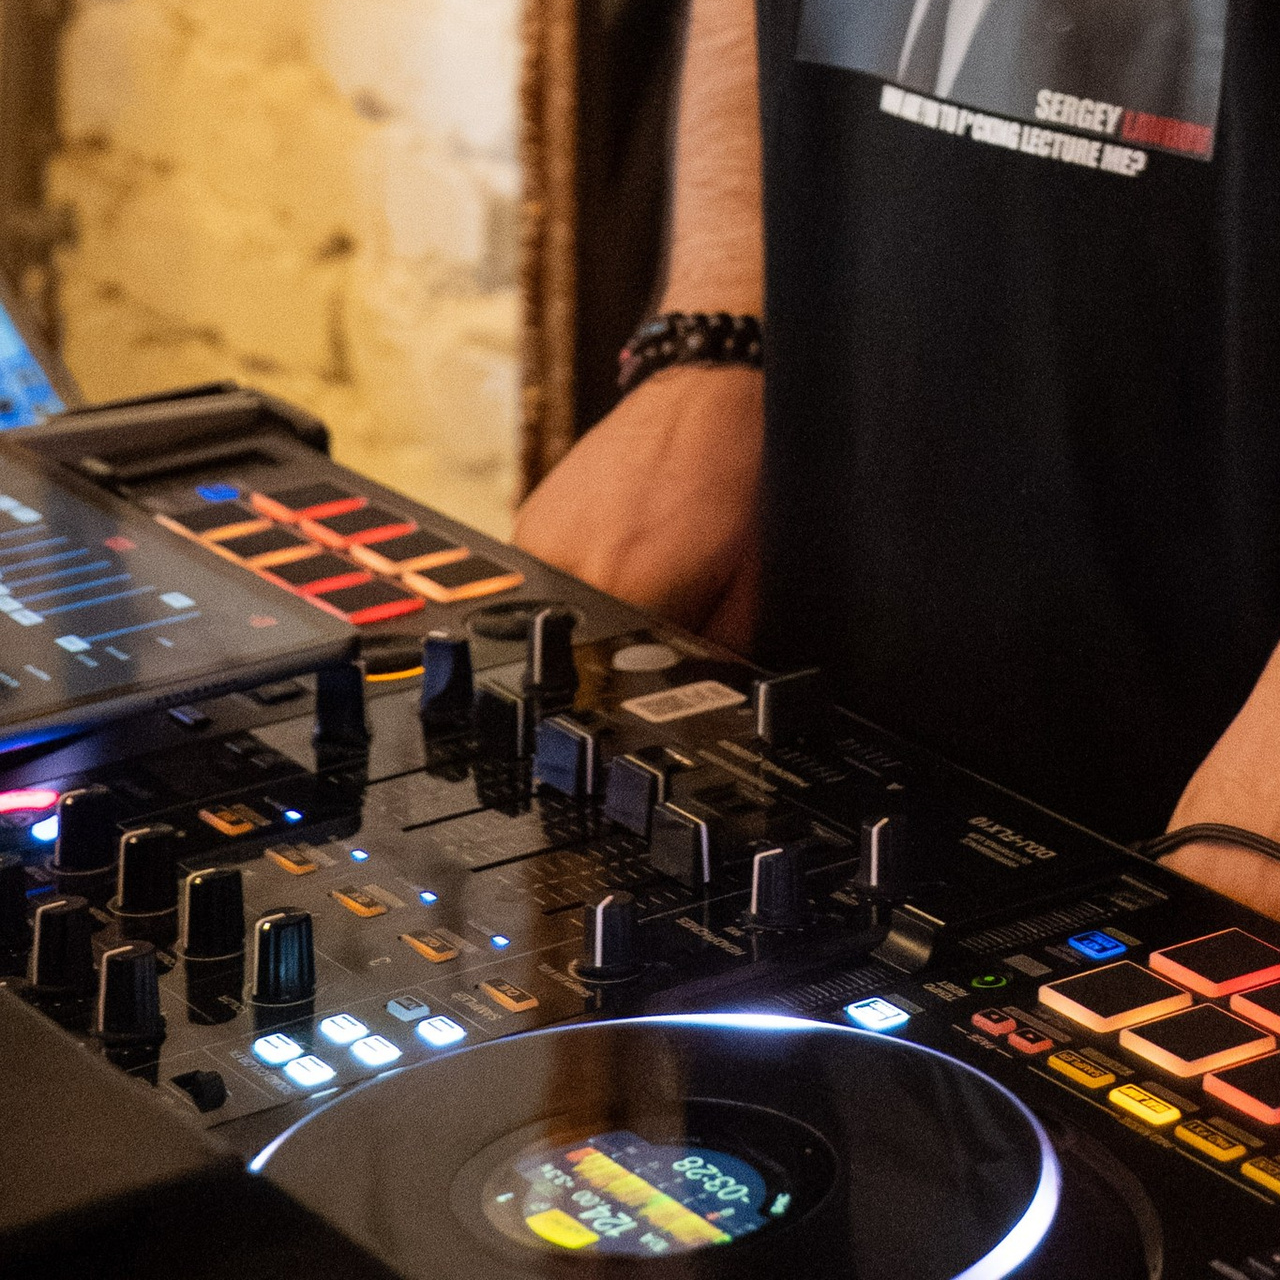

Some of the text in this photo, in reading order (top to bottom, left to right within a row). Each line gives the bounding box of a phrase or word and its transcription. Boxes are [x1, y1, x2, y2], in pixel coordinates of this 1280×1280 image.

[1034, 89, 1125, 134] SERGEY
[1017, 126, 1102, 170] LECTURE
[1058, 1052, 1101, 1078] SAMPLER
[672, 1156, 751, 1204] -03:28
[571, 1189, 638, 1237] 124.00
